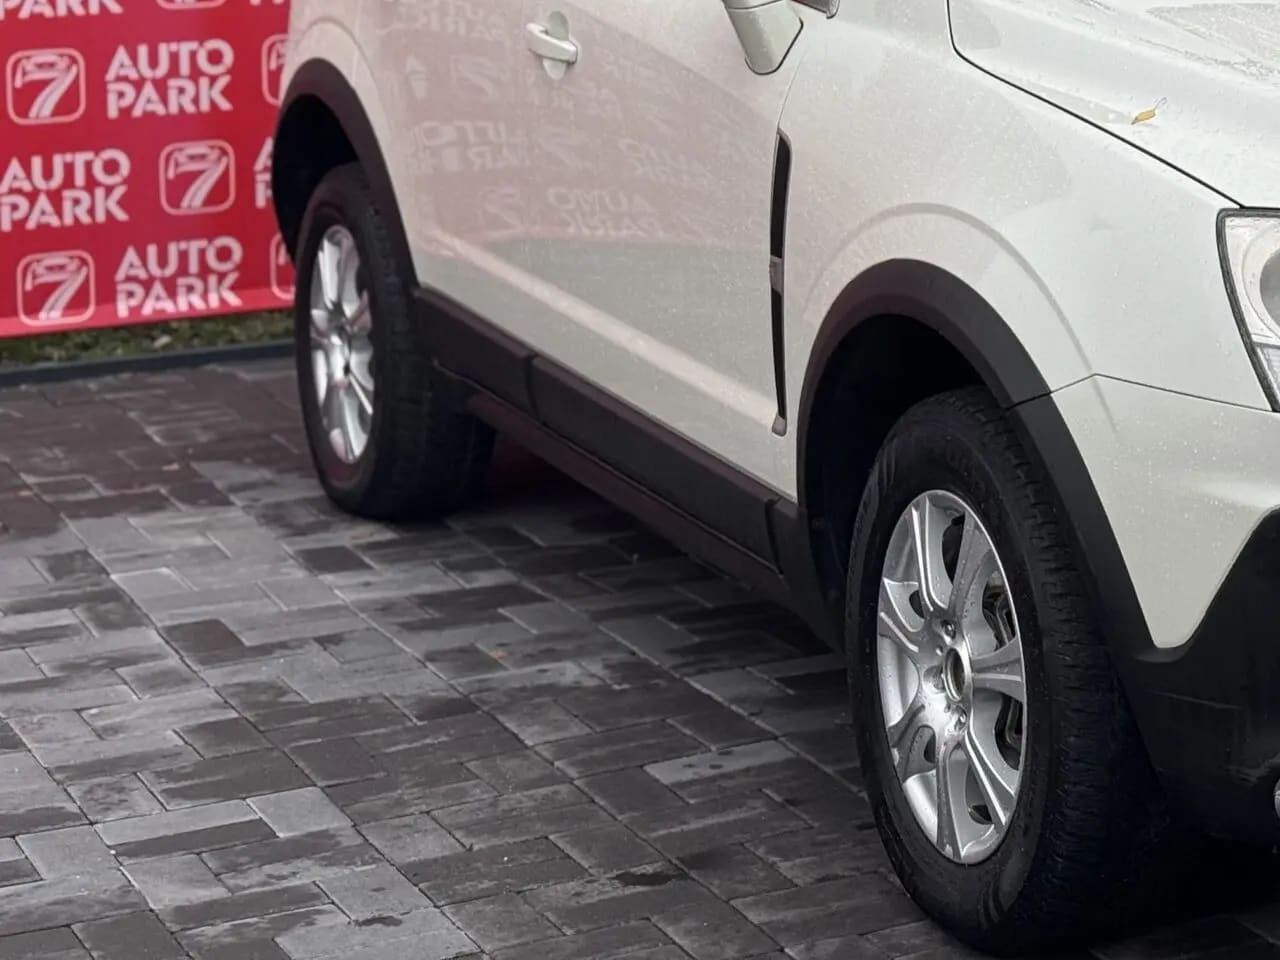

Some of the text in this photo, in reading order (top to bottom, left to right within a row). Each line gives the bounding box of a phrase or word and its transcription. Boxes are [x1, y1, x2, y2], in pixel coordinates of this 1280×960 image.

[105, 39, 235, 81] AUTO
[106, 76, 234, 119] PARK
[0, 148, 131, 194] AUTO
[0, 186, 129, 232] PARK
[114, 236, 243, 281] AUTO
[115, 271, 243, 318] PARK
